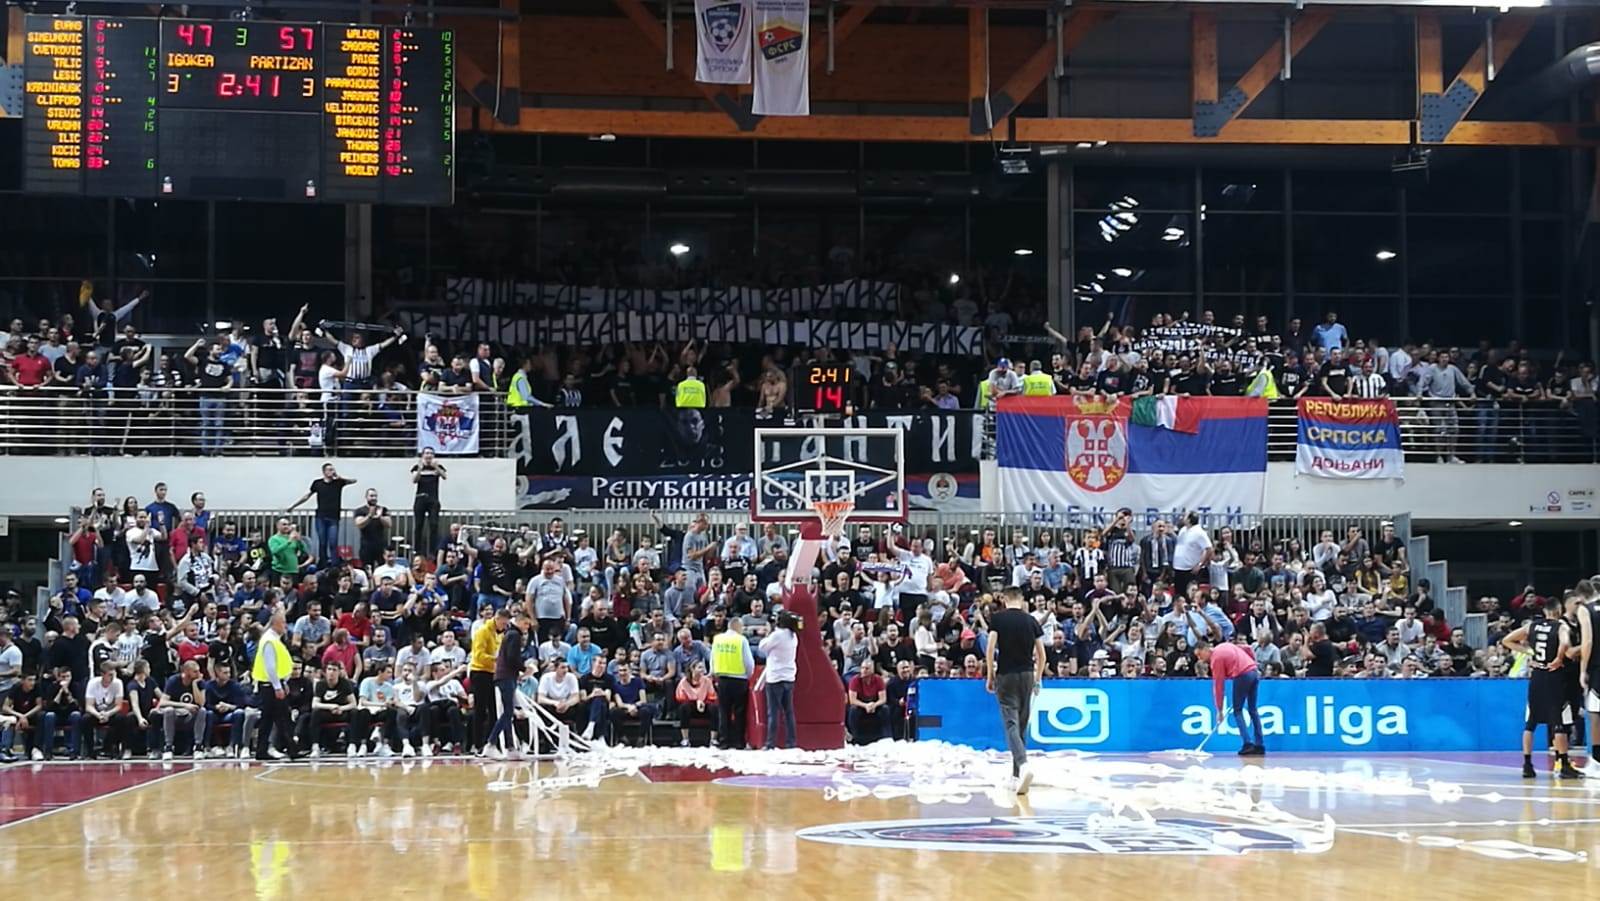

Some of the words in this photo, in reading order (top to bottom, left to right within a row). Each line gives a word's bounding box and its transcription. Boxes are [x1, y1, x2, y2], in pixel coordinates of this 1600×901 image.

[178, 24, 213, 46] 47
[236, 28, 248, 46] 3
[280, 26, 314, 50] 57
[444, 44, 452, 54] 5
[54, 58, 82, 69] TALIC
[148, 59, 155, 69] 2
[167, 54, 214, 68] IGOKEA
[250, 56, 313, 71] PARTIZAN
[53, 70, 81, 81] LESIC
[346, 66, 380, 77] GORDIC
[167, 74, 179, 93] 3
[219, 74, 280, 97] 2:41
[303, 78, 314, 97] 3
[444, 82, 452, 91] 2
[37, 95, 81, 106] CLIFFORD
[148, 97, 155, 106] 4
[47, 108, 81, 118] STEVIC
[148, 110, 155, 119] 2
[144, 122, 154, 132] 15
[58, 133, 81, 143] ILIC
[444, 131, 451, 140] 5
[147, 160, 154, 169] 6
[444, 155, 451, 165] 2
[847, 319, 984, 357] РЕПУБЛИКА
[810, 367, 850, 384] 2:41
[815, 386, 842, 409] 14
[1305, 399, 1388, 418] РЕПУБЛИКА
[1306, 426, 1388, 445] СРПСКА
[1311, 456, 1385, 472] ДОЊАНИ
[1535, 641, 1547, 662] 5
